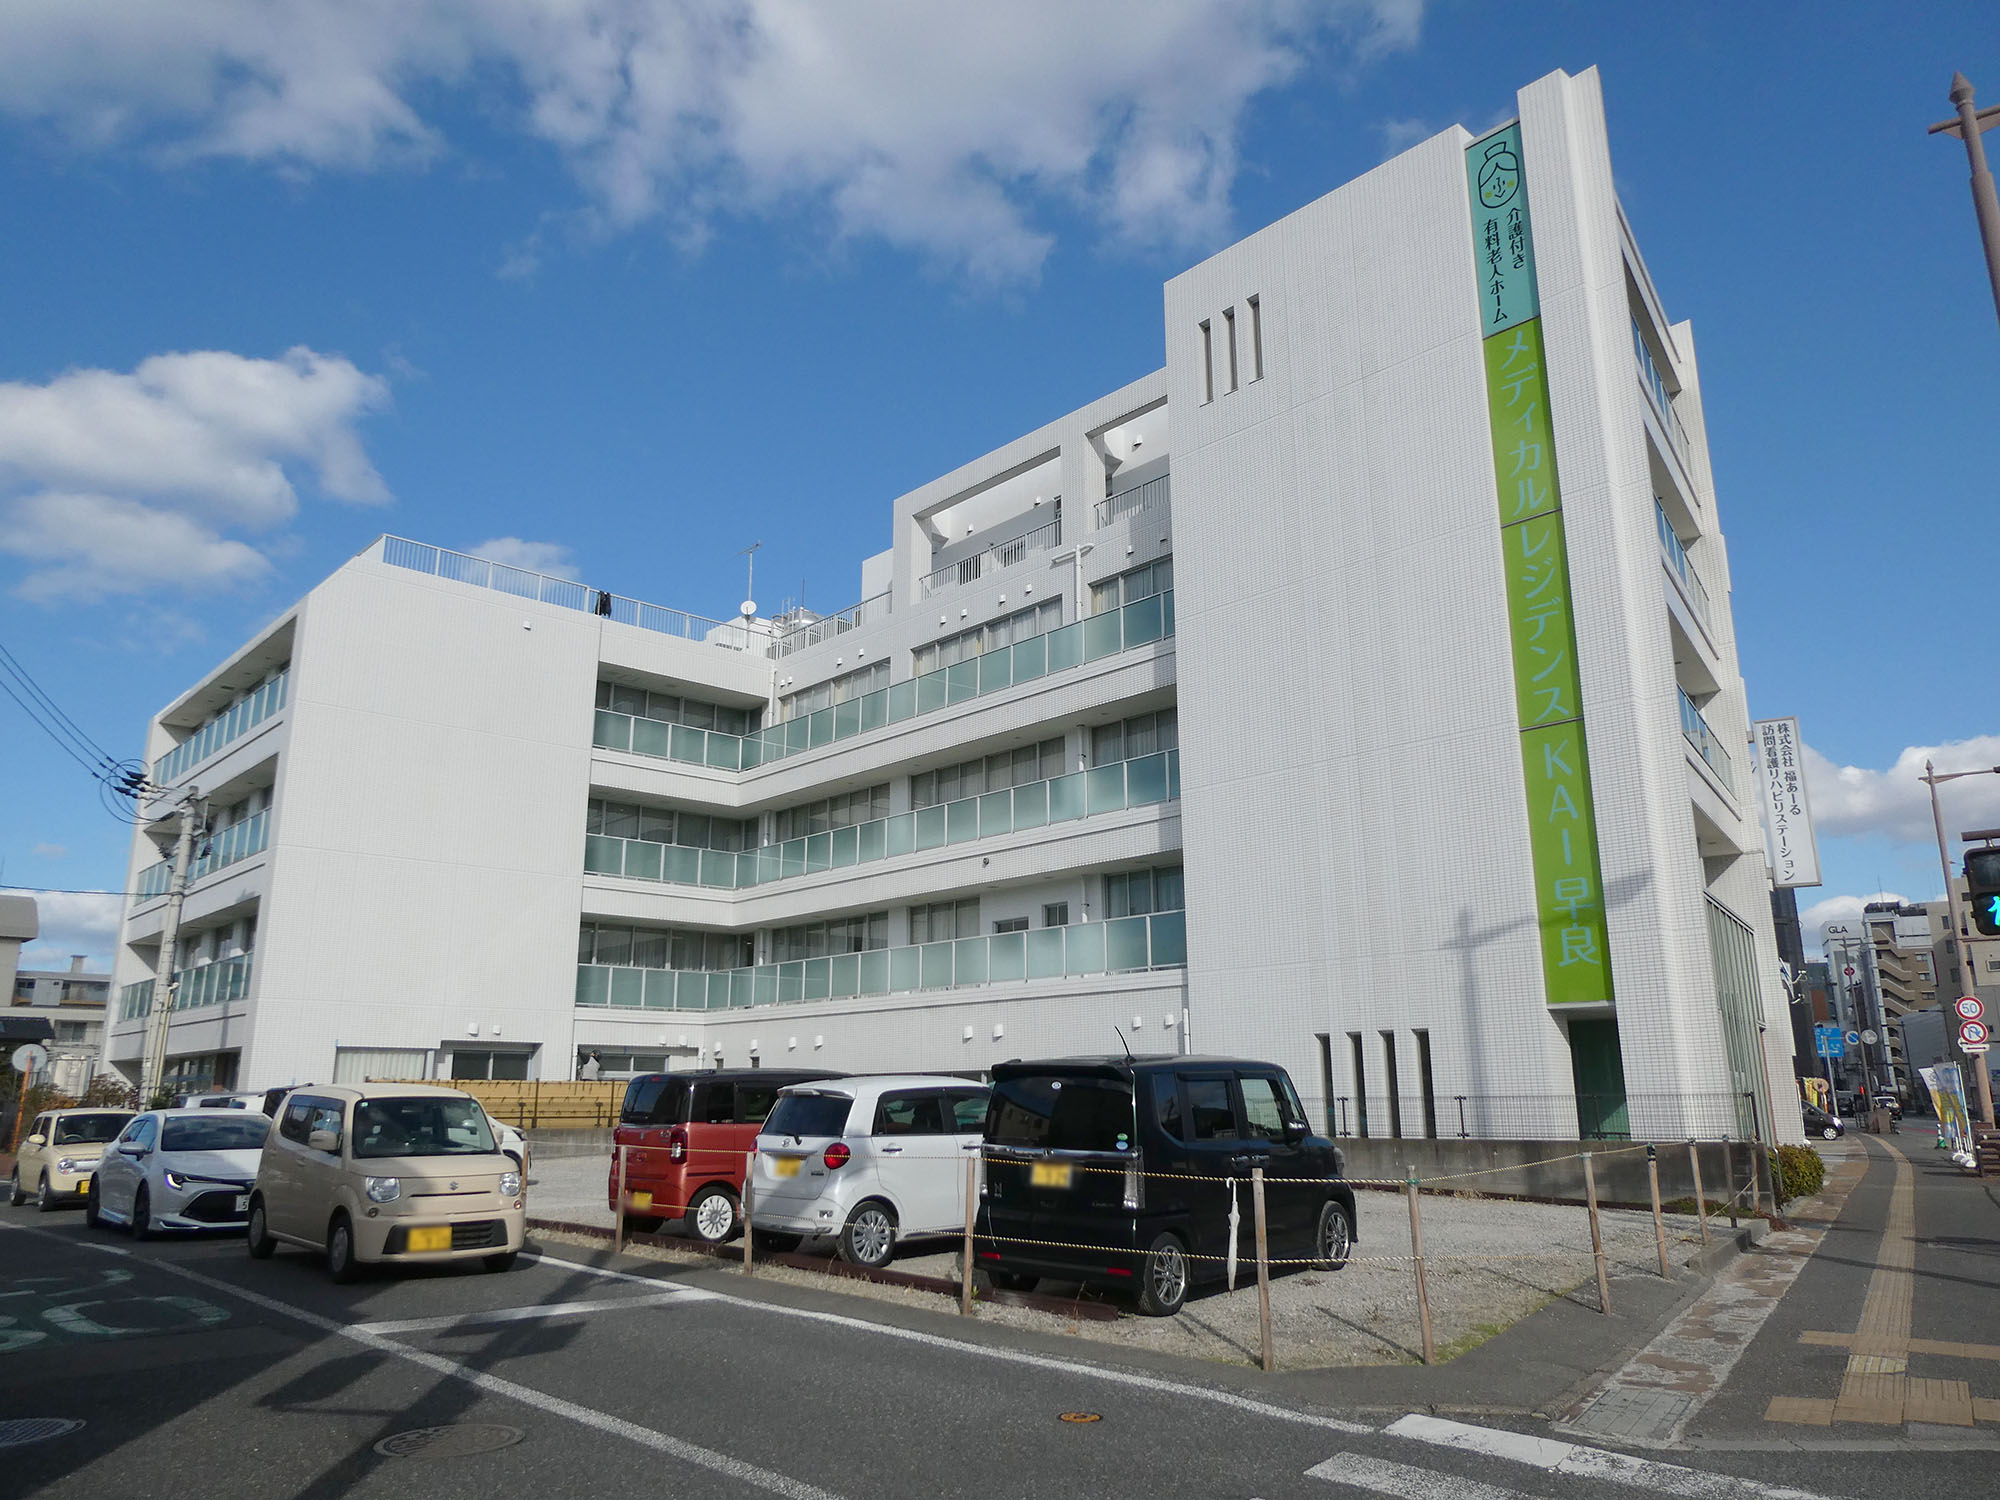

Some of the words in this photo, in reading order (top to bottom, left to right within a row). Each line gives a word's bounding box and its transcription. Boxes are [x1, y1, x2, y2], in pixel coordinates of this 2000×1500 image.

[1507, 207, 1526, 269] 介護付き
[1483, 218, 1508, 324] 有料老人ホーム
[1777, 723, 1795, 767] 株式会社
[1762, 724, 1796, 881] 訪問看護リハビリステーション
[1784, 770, 1801, 816] 福あーる
[1828, 926, 1848, 934] GLA
[1962, 1002, 1978, 1014] 50
